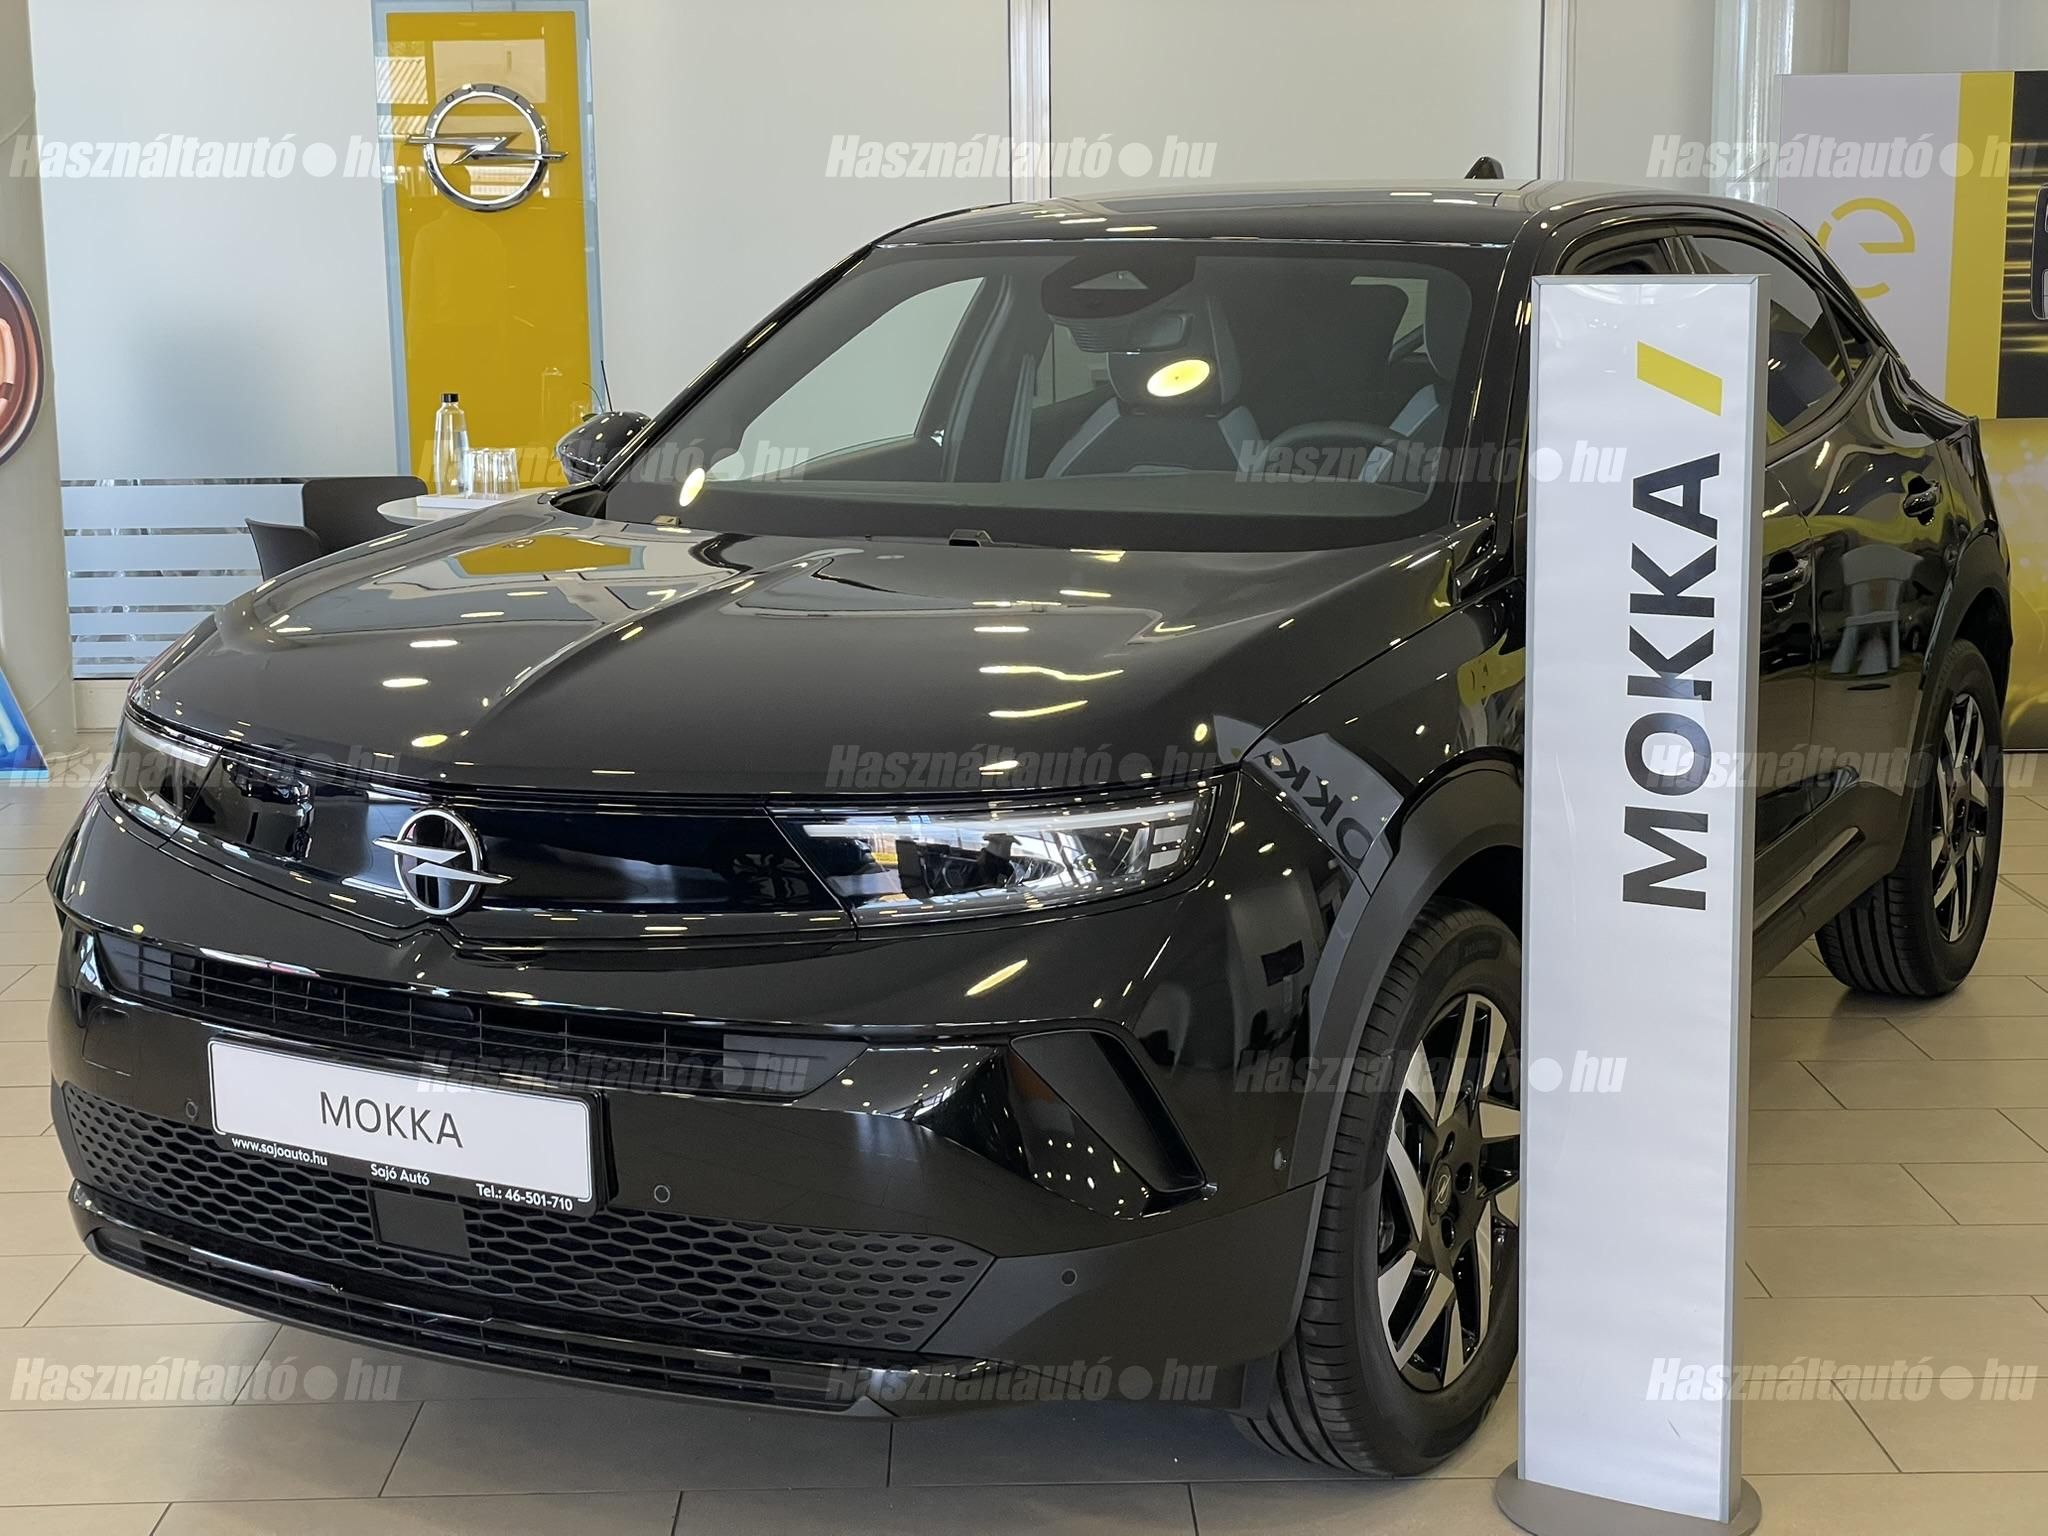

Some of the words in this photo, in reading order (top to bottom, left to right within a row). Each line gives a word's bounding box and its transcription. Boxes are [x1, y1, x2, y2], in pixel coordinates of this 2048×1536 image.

[1622, 452, 1721, 911] MOKKA
[320, 1091, 464, 1148] MOKKA
[232, 1138, 329, 1166] www.sajoauto.hu
[371, 1164, 397, 1181] Sajó
[400, 1168, 430, 1186] Autó
[476, 1183, 502, 1199] Tel.:
[505, 1188, 573, 1211] 46-501-710
